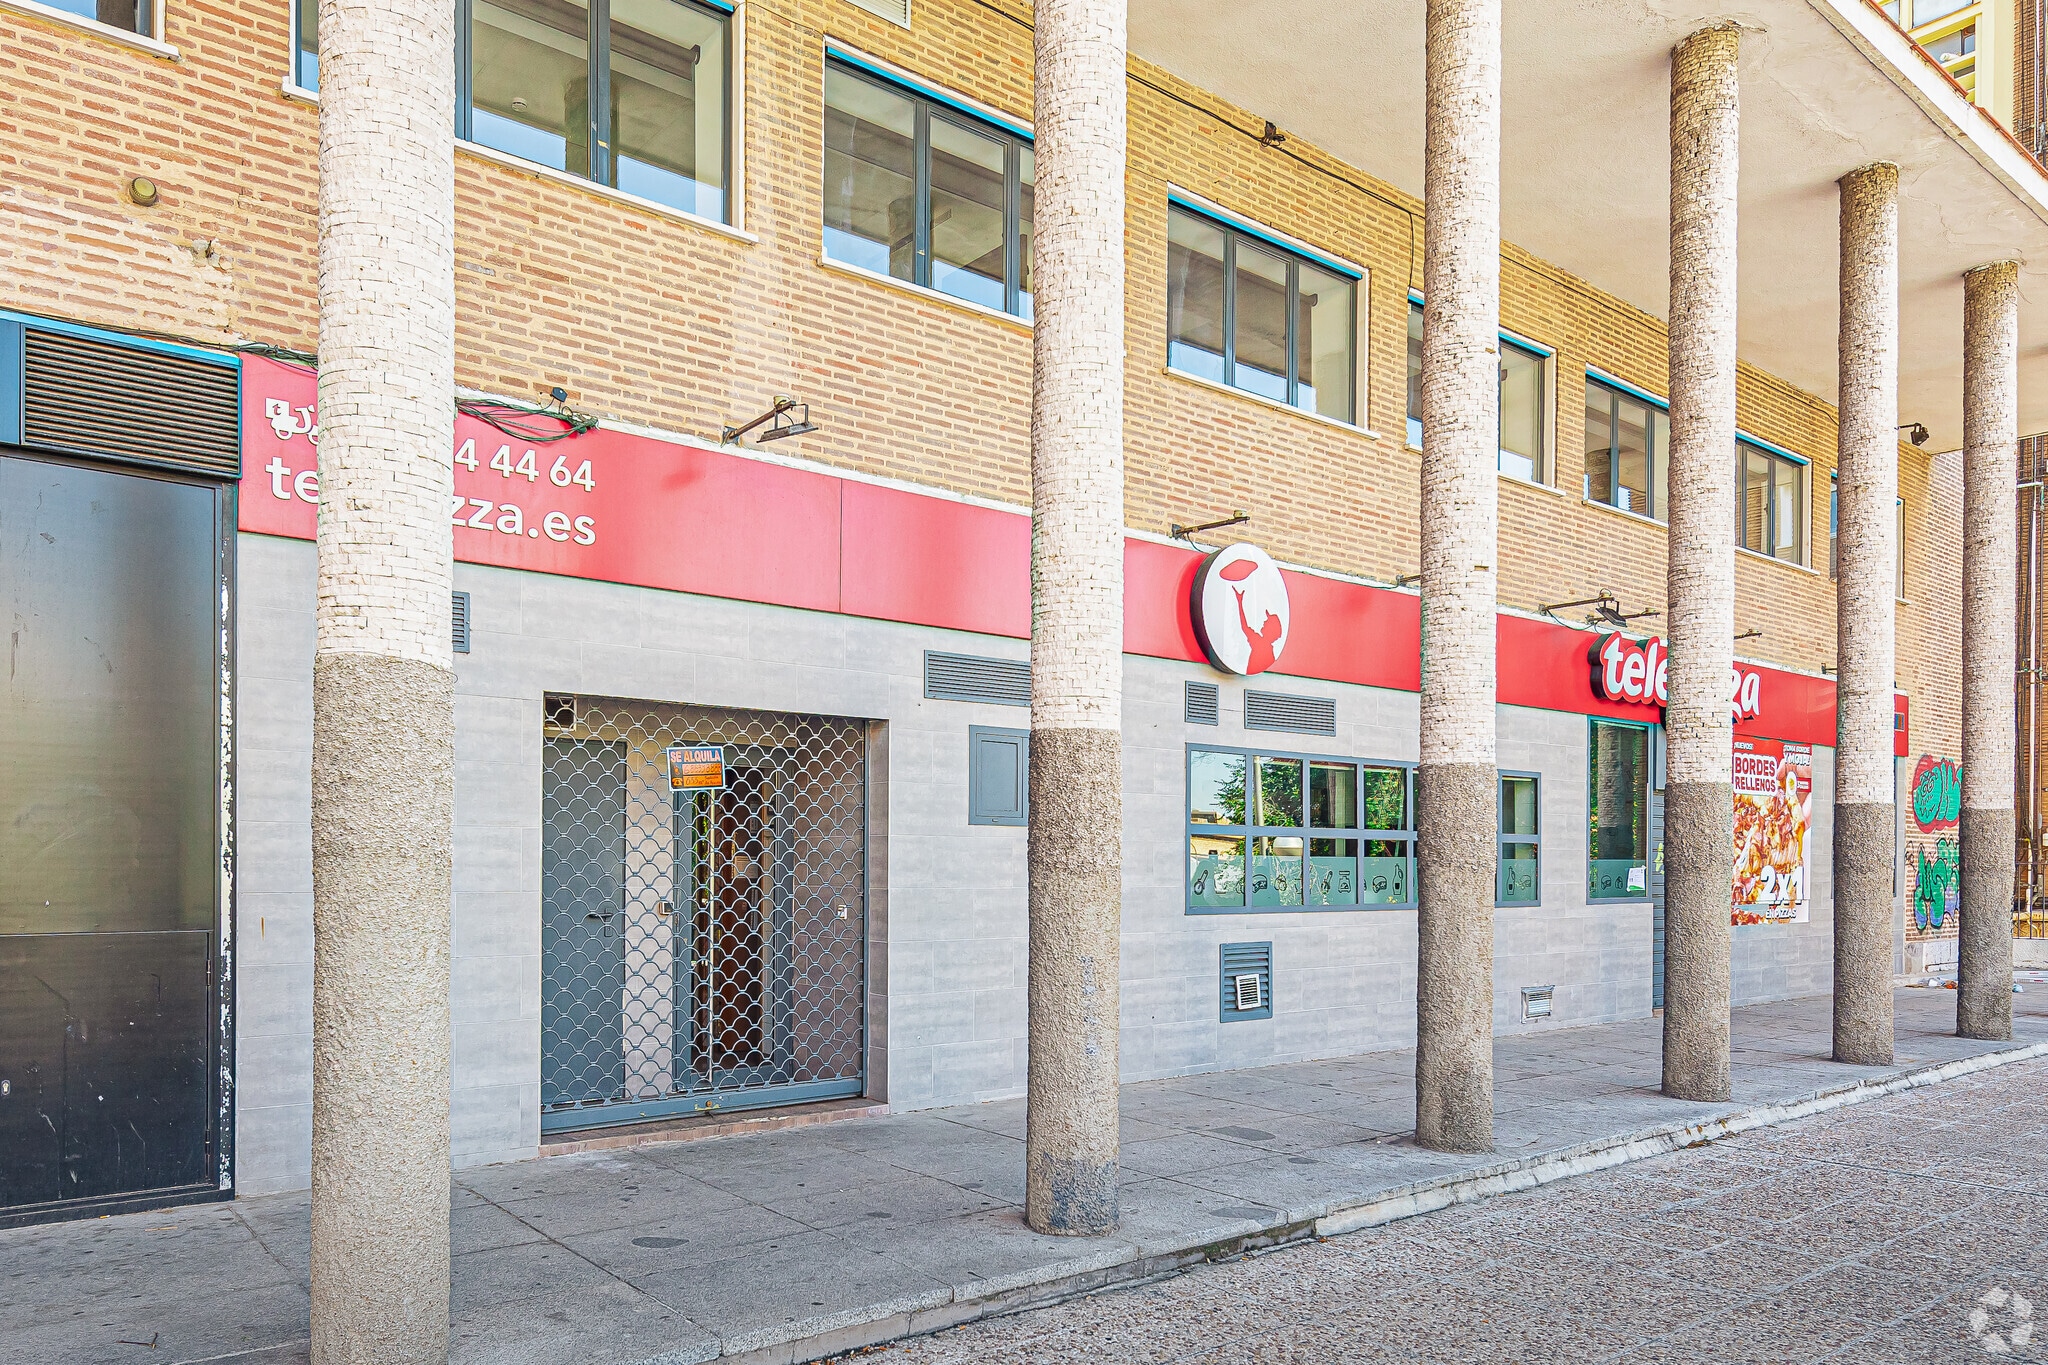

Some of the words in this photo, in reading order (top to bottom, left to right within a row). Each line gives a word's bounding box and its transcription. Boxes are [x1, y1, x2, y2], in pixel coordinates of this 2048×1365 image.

[489, 444, 540, 482] 44
[549, 455, 596, 492] 64
[670, 751, 682, 763] SE
[683, 750, 721, 763] ALQUILA
[1735, 757, 1776, 777] BORDES
[1735, 776, 1776, 792] RELLENOS
